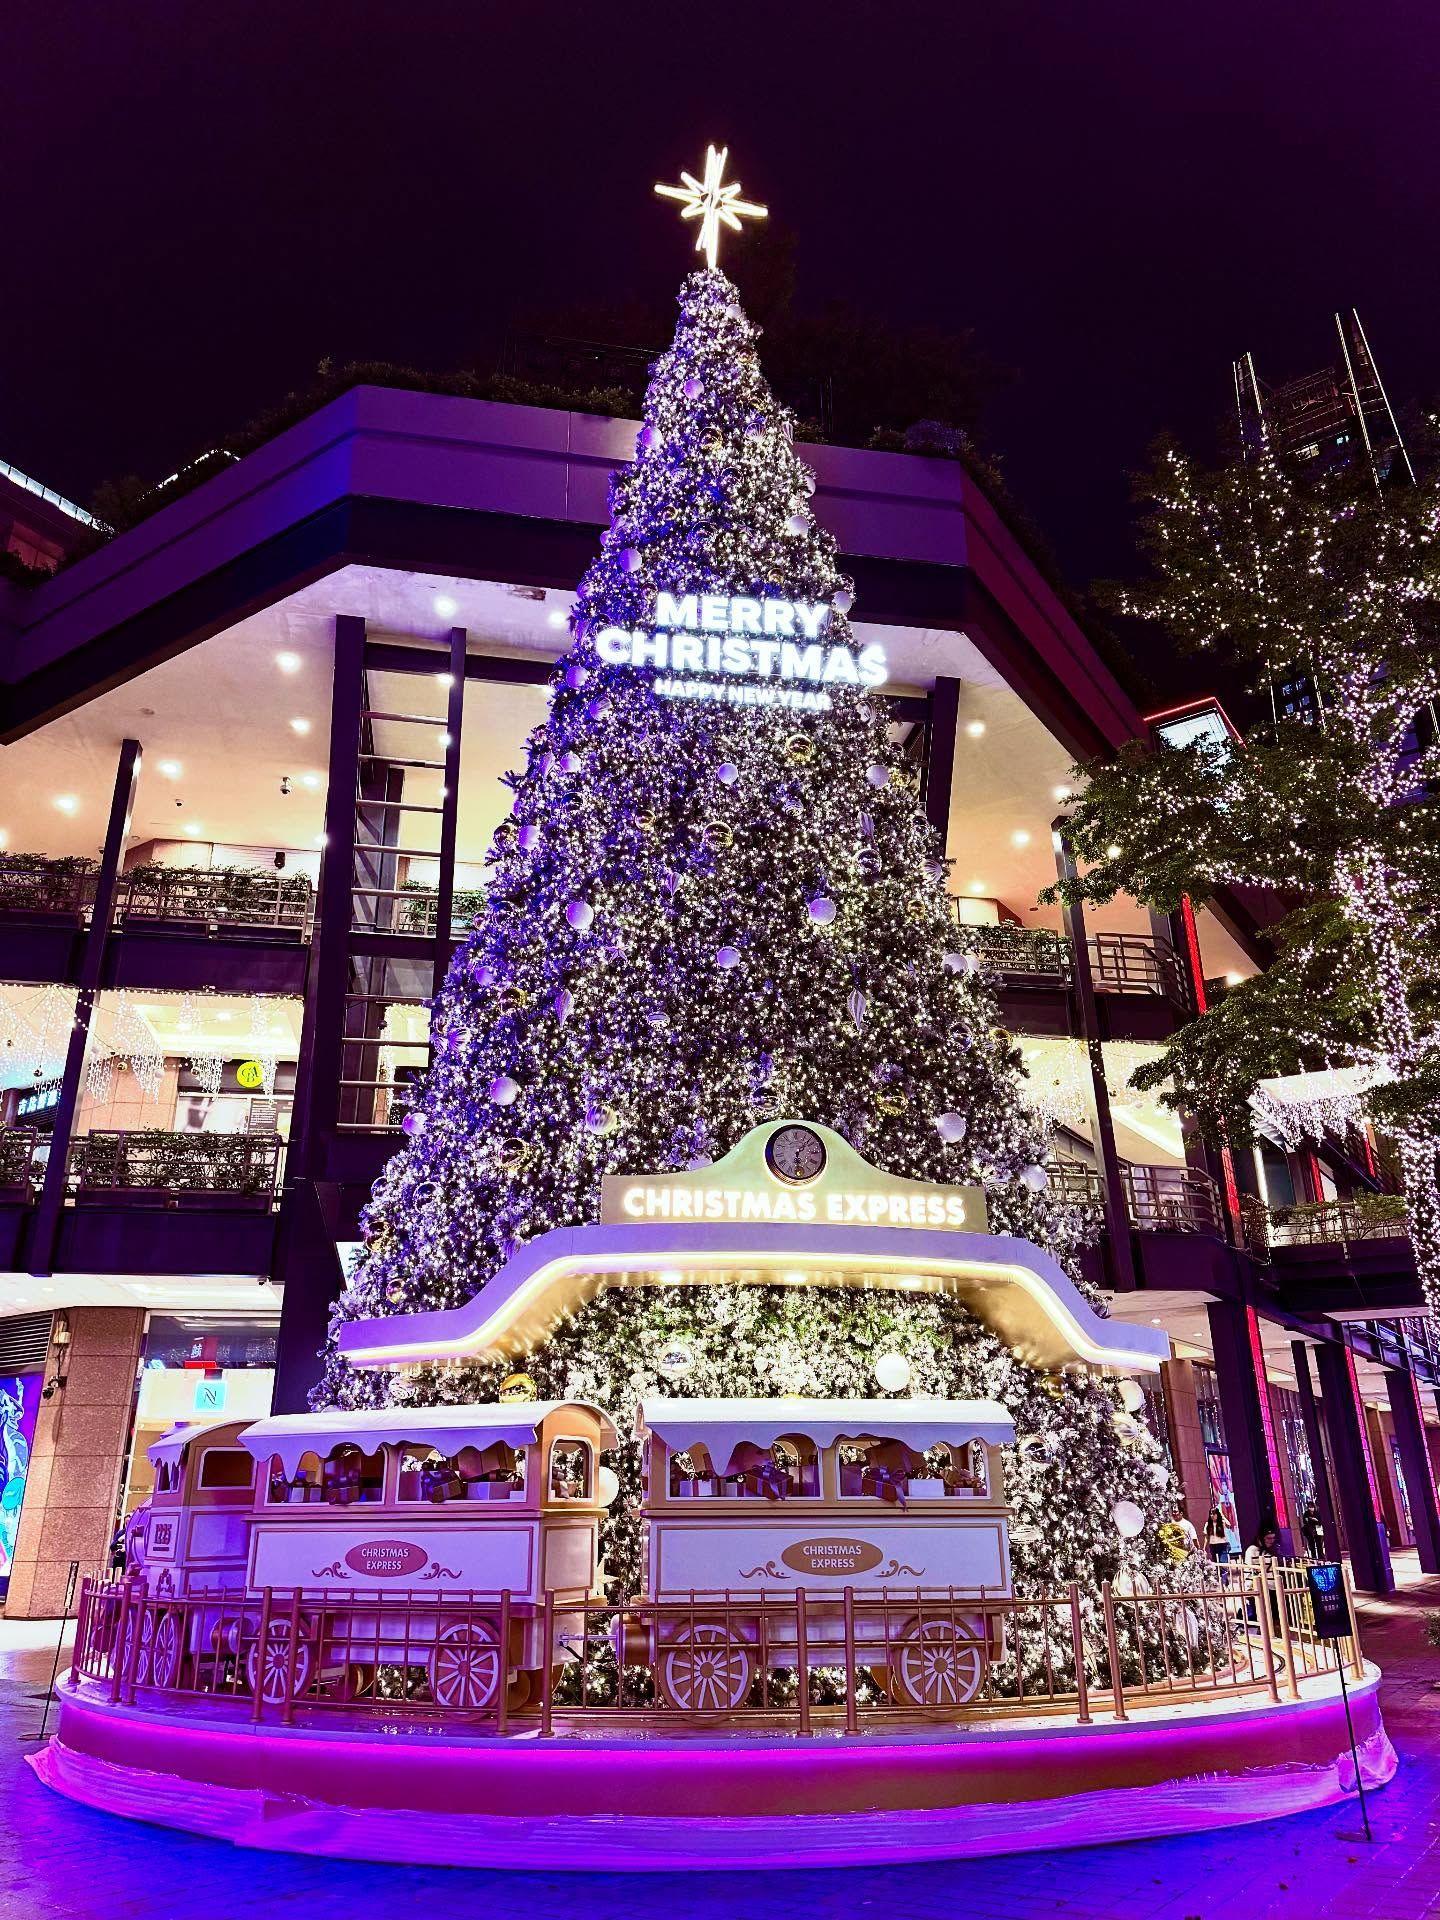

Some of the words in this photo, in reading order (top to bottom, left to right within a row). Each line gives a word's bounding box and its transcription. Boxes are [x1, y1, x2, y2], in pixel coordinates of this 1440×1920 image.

[656, 592, 830, 637] MERRY
[596, 627, 889, 687] CHRISTMAS
[654, 678, 726, 701] HAPPY
[728, 685, 773, 706] NEW
[776, 689, 833, 711] YEAR
[623, 1187, 817, 1222] CHRISTMAS
[825, 1193, 966, 1226] EXPRESS
[361, 1548, 409, 1558] CHRISTMAS
[802, 1545, 862, 1556] CHRISTMAS
[366, 1560, 402, 1570] EXPRESS
[811, 1558, 855, 1569] EXPRESS
